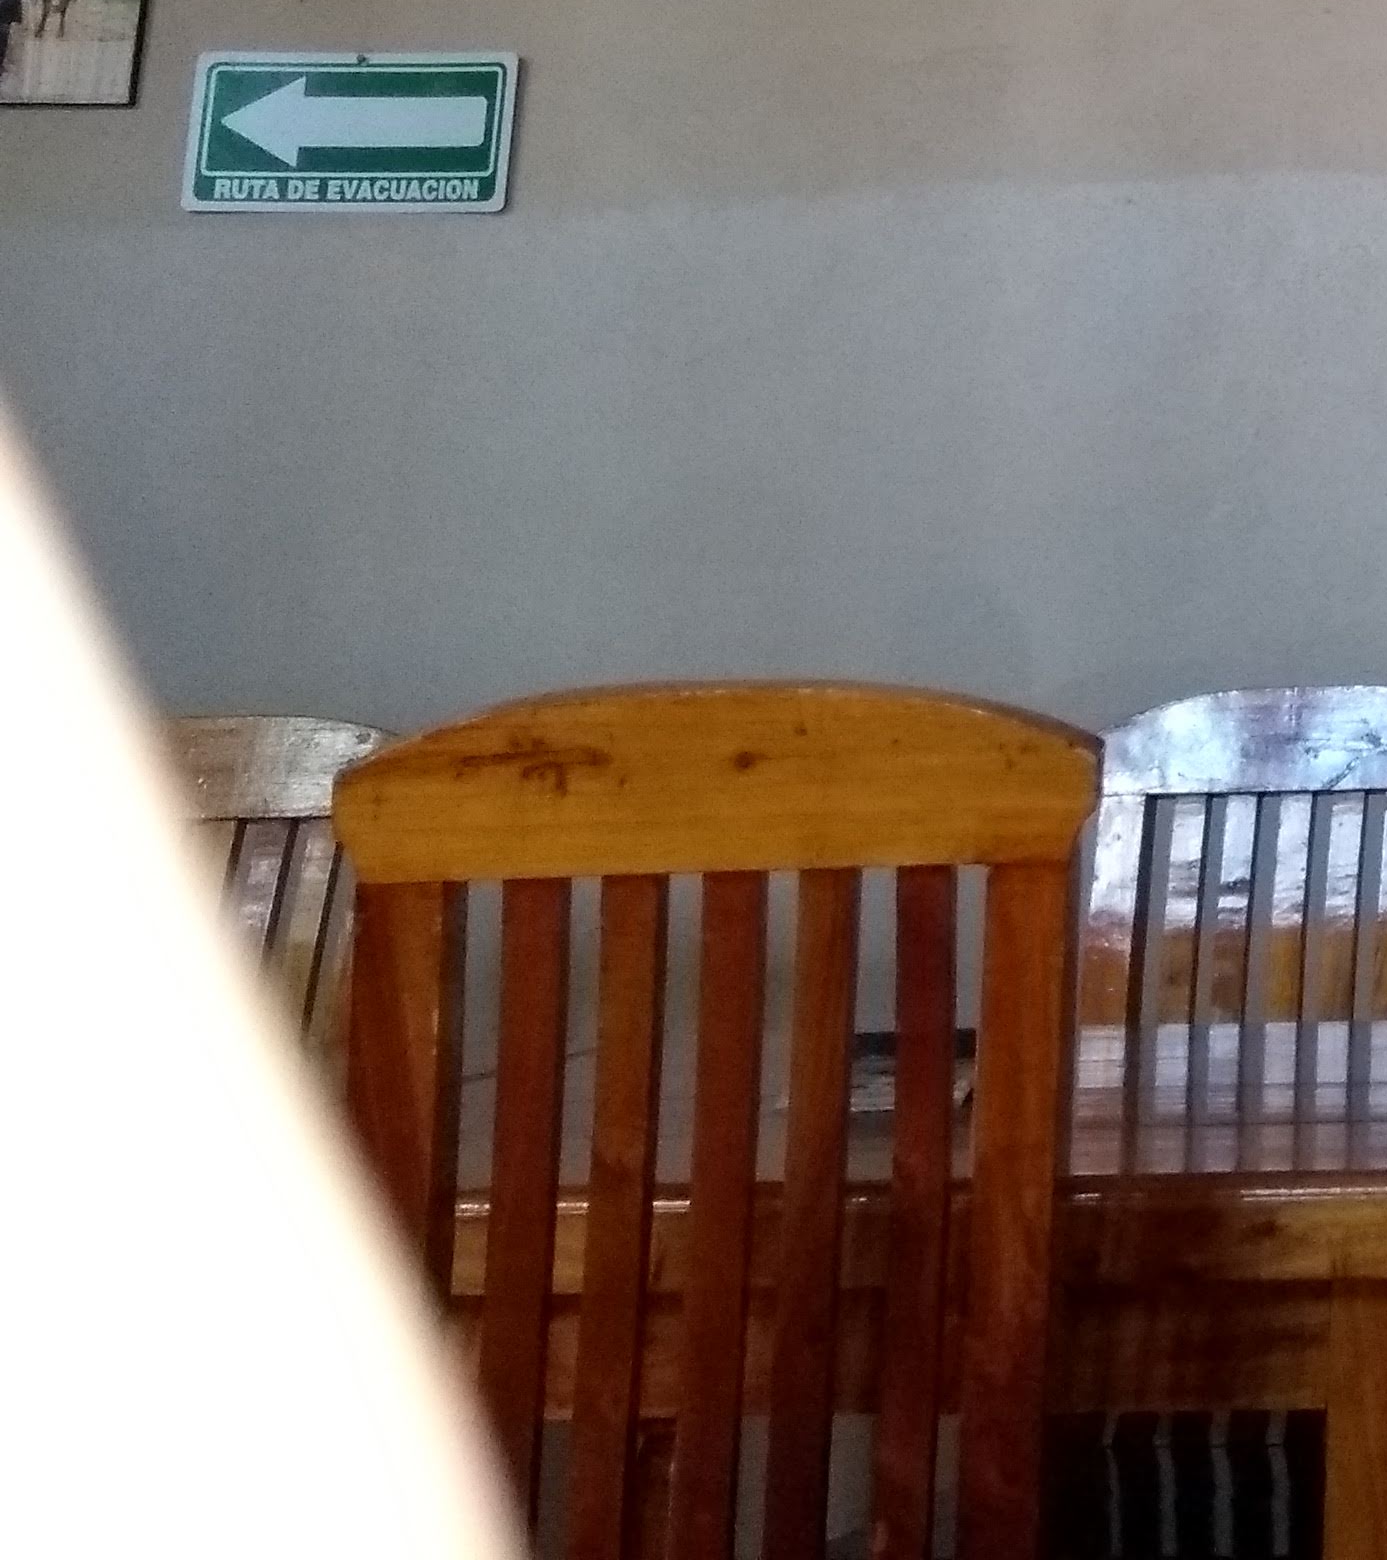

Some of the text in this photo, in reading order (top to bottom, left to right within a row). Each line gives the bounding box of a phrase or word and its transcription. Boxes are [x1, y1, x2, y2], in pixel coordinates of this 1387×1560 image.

[213, 178, 480, 201] RUTA DE EVACUACION
